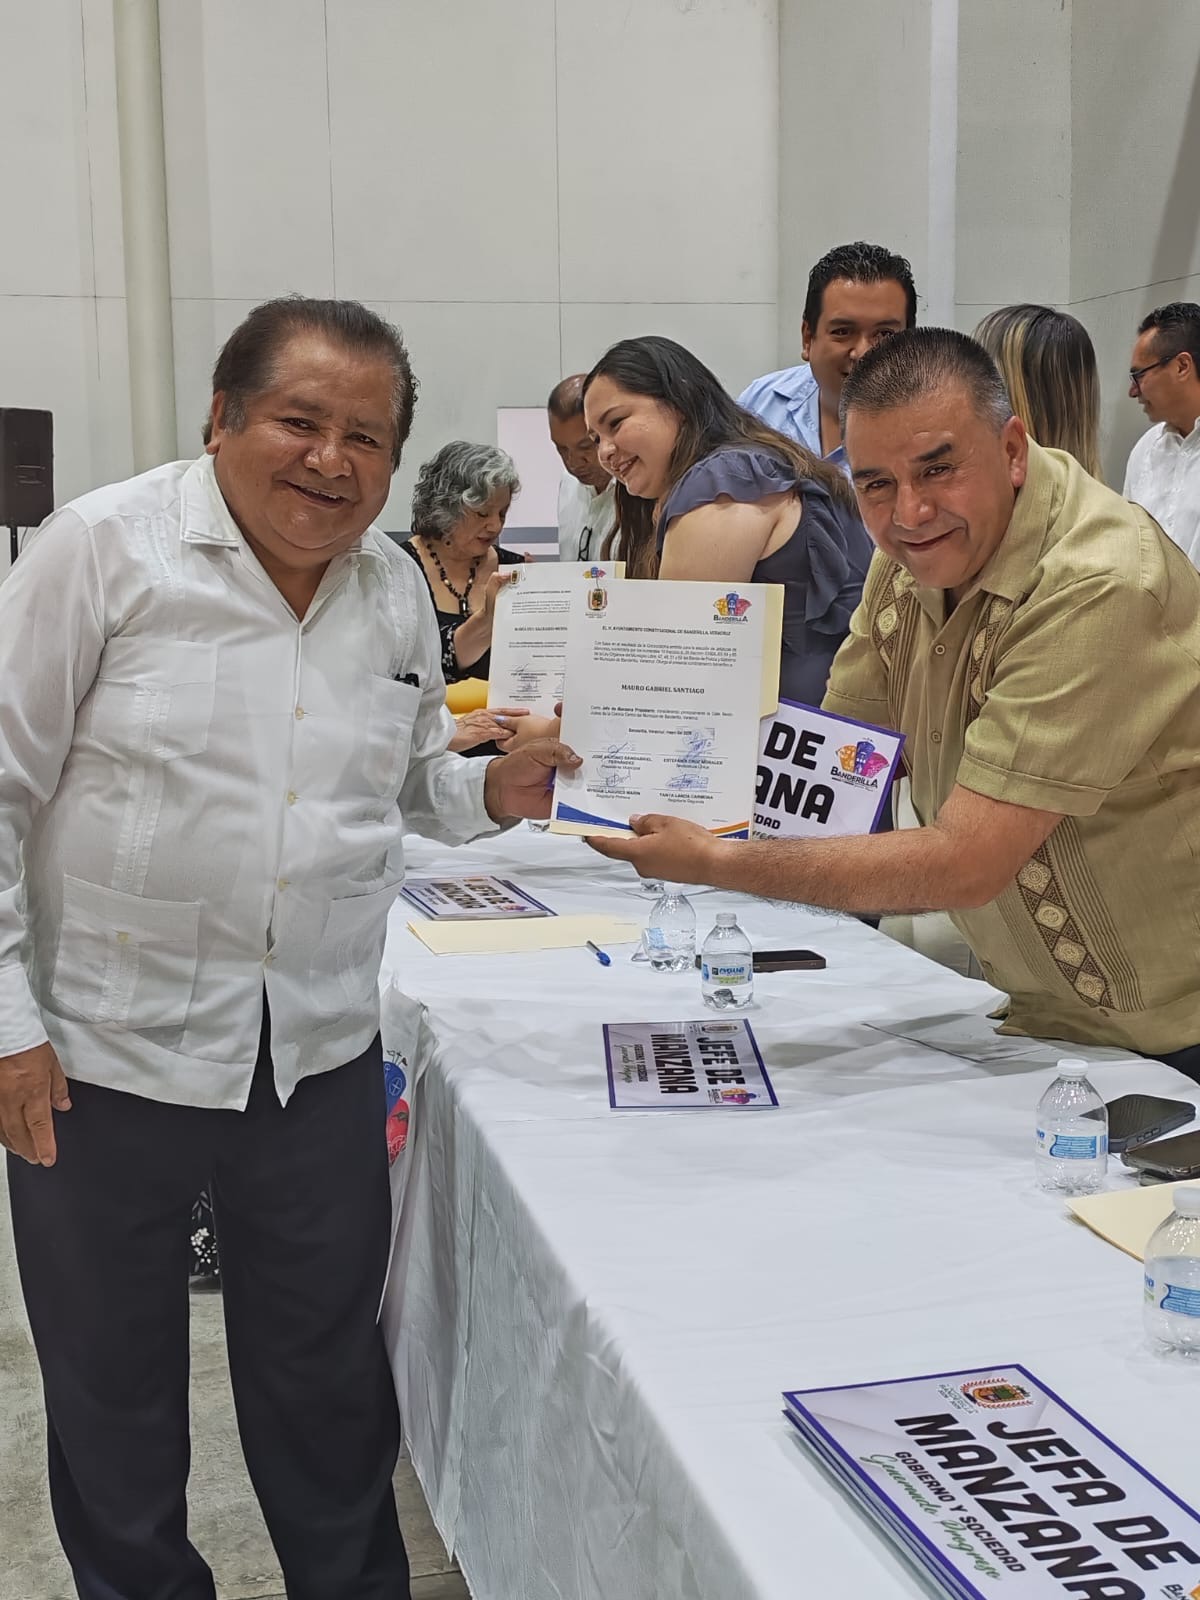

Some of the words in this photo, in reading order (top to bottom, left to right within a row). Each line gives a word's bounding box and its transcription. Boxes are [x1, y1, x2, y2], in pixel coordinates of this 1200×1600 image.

[763, 720, 826, 771] DE
[755, 765, 835, 825] ANA
[830, 765, 878, 789] BANDERILLA
[753, 812, 781, 830] DAD
[430, 882, 487, 909] MANZANA
[650, 1033, 700, 1094] MANZANA
[696, 1037, 740, 1066] JEFE
[704, 1068, 746, 1085] DE
[859, 1454, 942, 1518] Generando
[934, 1519, 1002, 1581] Progreso
[894, 1413, 1146, 1600] MANZANA
[894, 1451, 956, 1503] GOBIERNO
[949, 1504, 968, 1513] Y
[959, 1515, 1027, 1573] SOCIEDAD
[986, 1420, 1127, 1508] JEFA
[1093, 1515, 1200, 1571] DE
